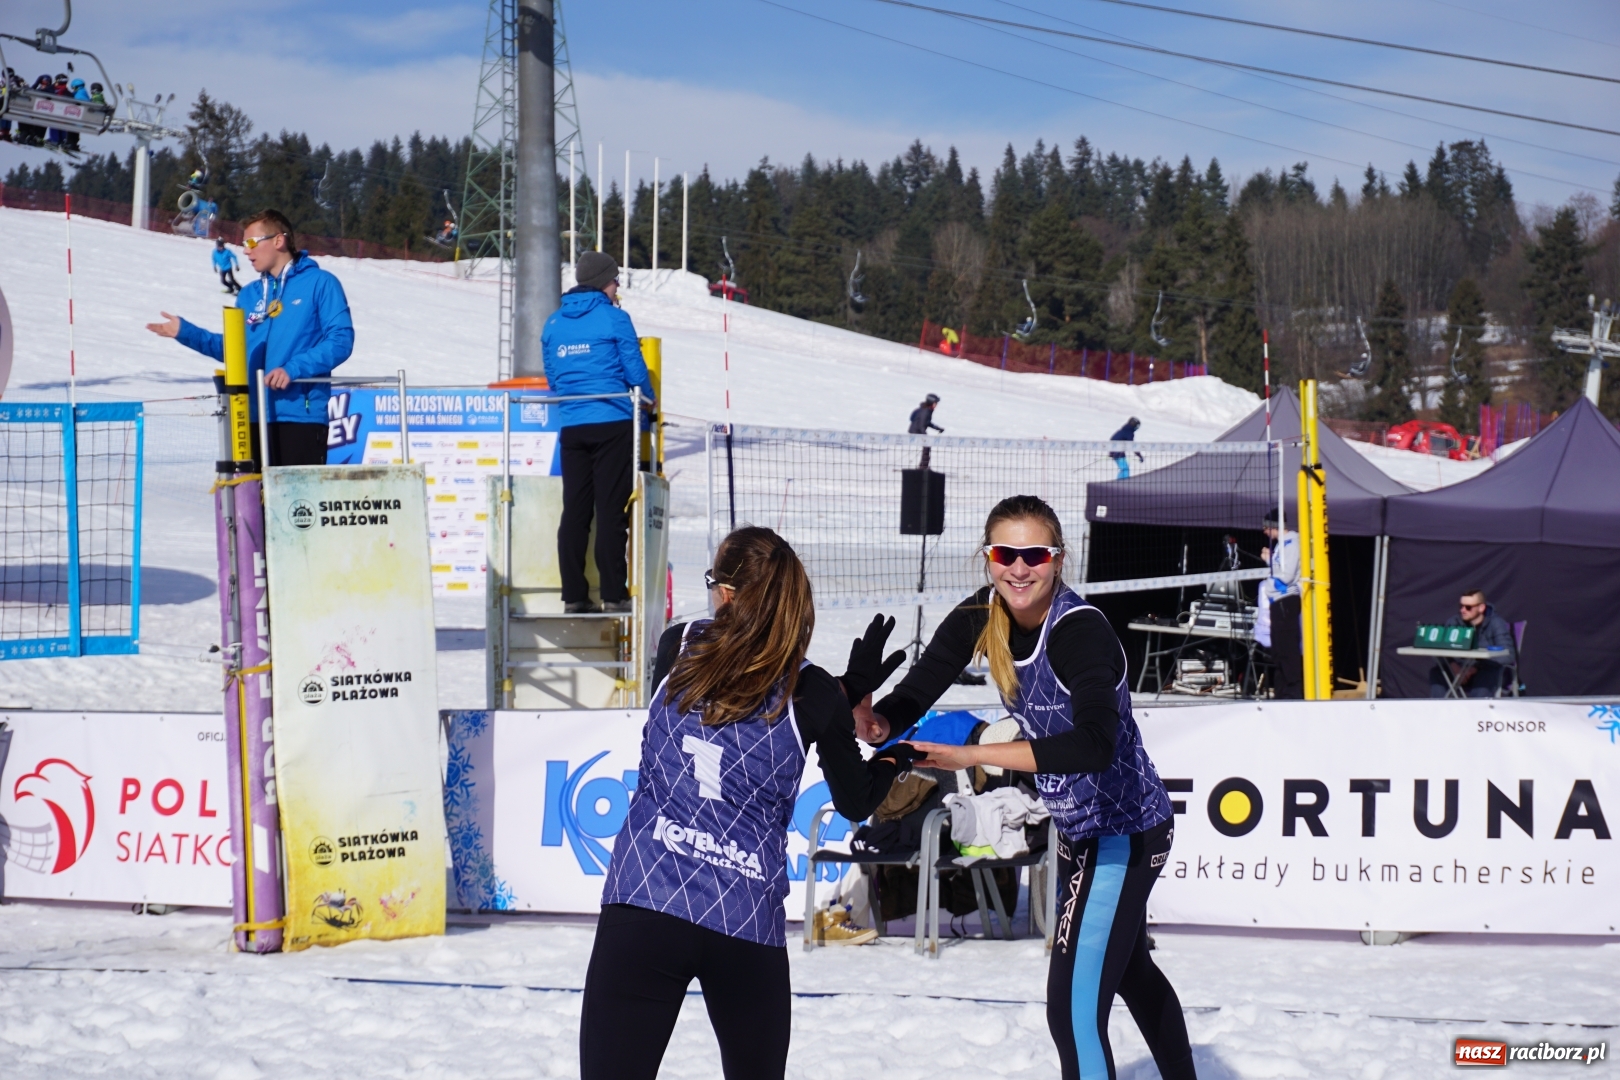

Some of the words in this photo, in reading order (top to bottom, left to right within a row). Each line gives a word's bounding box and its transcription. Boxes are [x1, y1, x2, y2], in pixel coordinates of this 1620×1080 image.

[375, 395, 463, 412] MISRZOSTWA
[466, 396, 505, 412] POLSK
[319, 496, 401, 512] SIATKÓWKA
[321, 512, 388, 527] PLAŻOWA
[330, 669, 413, 687] SIATKÓWKA
[332, 686, 399, 701] PLAŻOWA
[1477, 721, 1547, 732] SPONSOR
[197, 731, 226, 742] OFICJ
[681, 734, 726, 802] 1
[119, 777, 217, 818] POL
[1161, 776, 1612, 841] FORTUNA
[338, 829, 419, 848] SIATKÓWKA
[341, 846, 406, 862] PLAŻOWA
[1312, 857, 1596, 886] bukmacherskie
